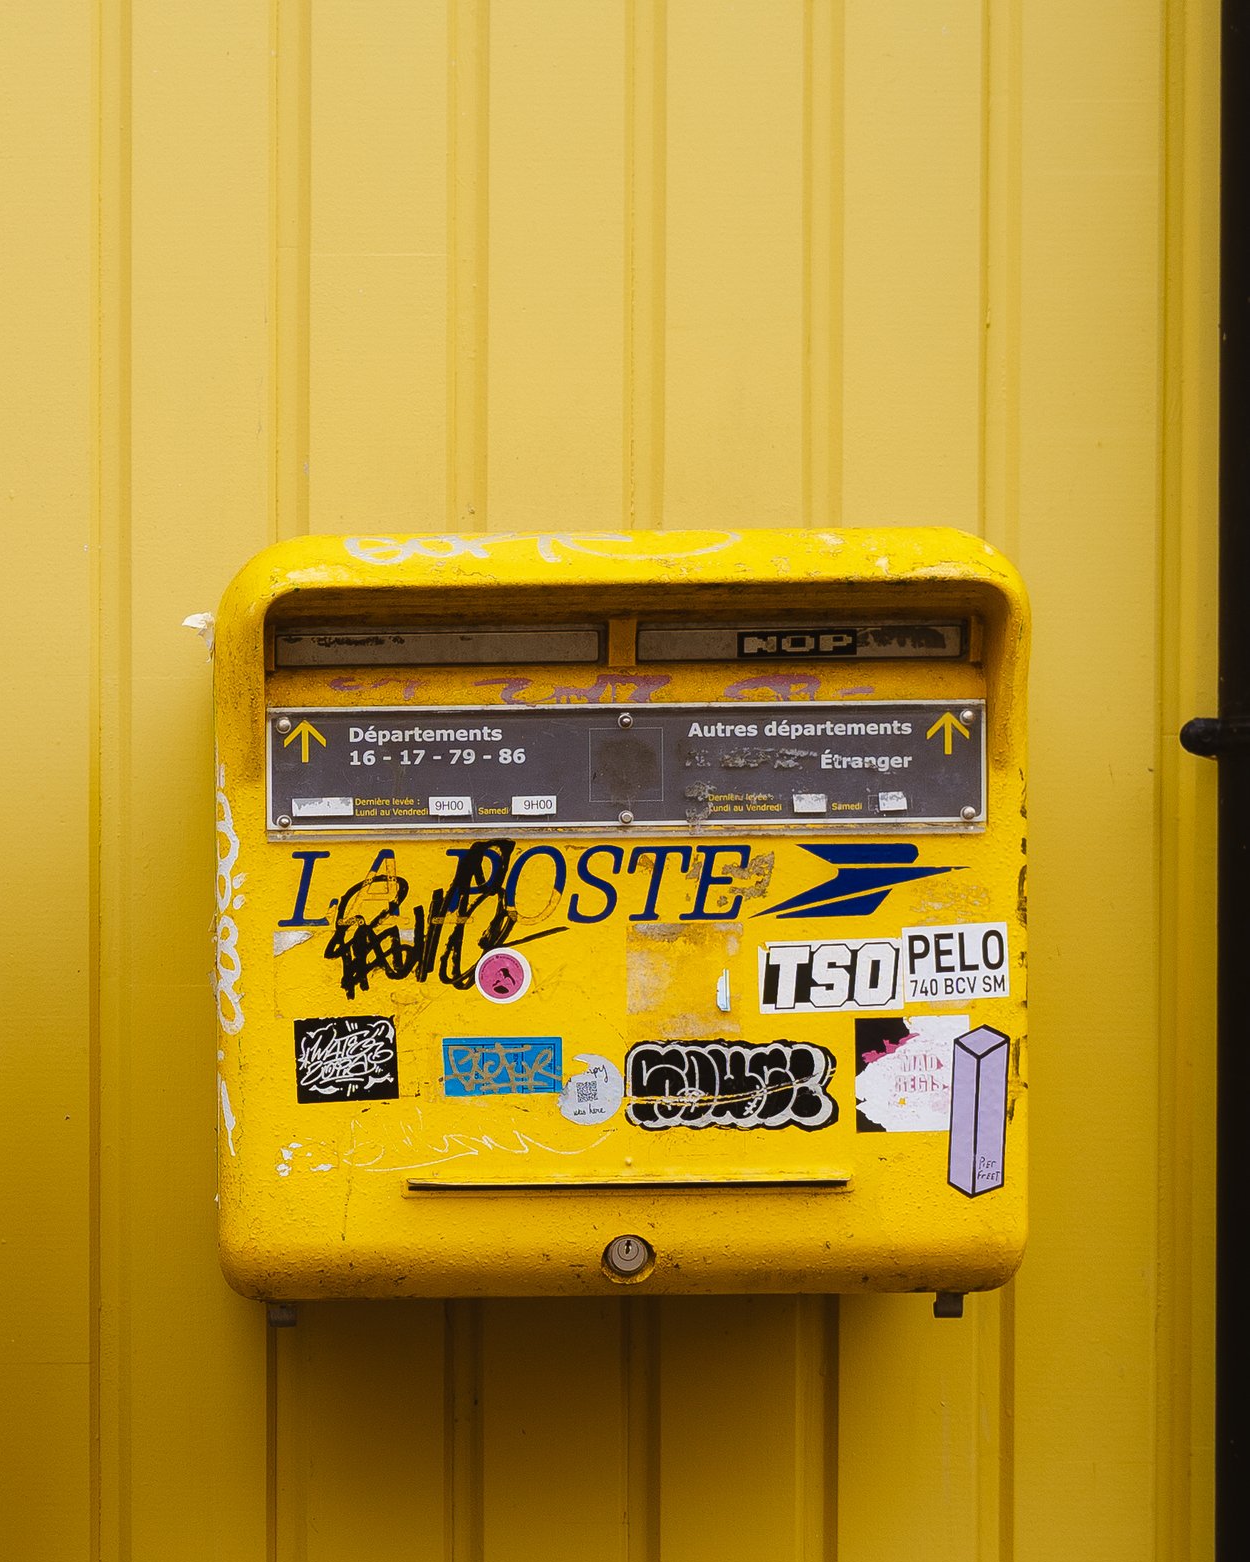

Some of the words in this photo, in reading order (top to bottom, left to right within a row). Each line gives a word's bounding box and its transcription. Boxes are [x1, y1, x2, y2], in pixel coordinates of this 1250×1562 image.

[743, 634, 852, 654] NOP
[349, 725, 503, 745] Départements
[688, 722, 758, 738] Autres
[764, 719, 913, 739] départements
[350, 750, 376, 766] 16
[400, 749, 426, 765] 17
[449, 749, 476, 765] 79
[498, 748, 526, 764] 86
[820, 749, 913, 771] Étranger
[355, 796, 390, 806] Dernière
[392, 796, 414, 806] levée
[434, 800, 464, 811] 9H00
[523, 799, 553, 810] 9H00
[746, 803, 782, 812] Vendredi
[831, 802, 863, 811] Samedi
[355, 807, 378, 816] Lundi
[392, 807, 428, 816] Vendredi
[478, 807, 509, 815] Samedi
[908, 930, 1004, 975] PELO
[769, 943, 896, 1009] TSO
[910, 979, 938, 997] 740
[944, 976, 977, 995] BCV
[983, 974, 1005, 993] SM
[589, 1103, 606, 1114] here
